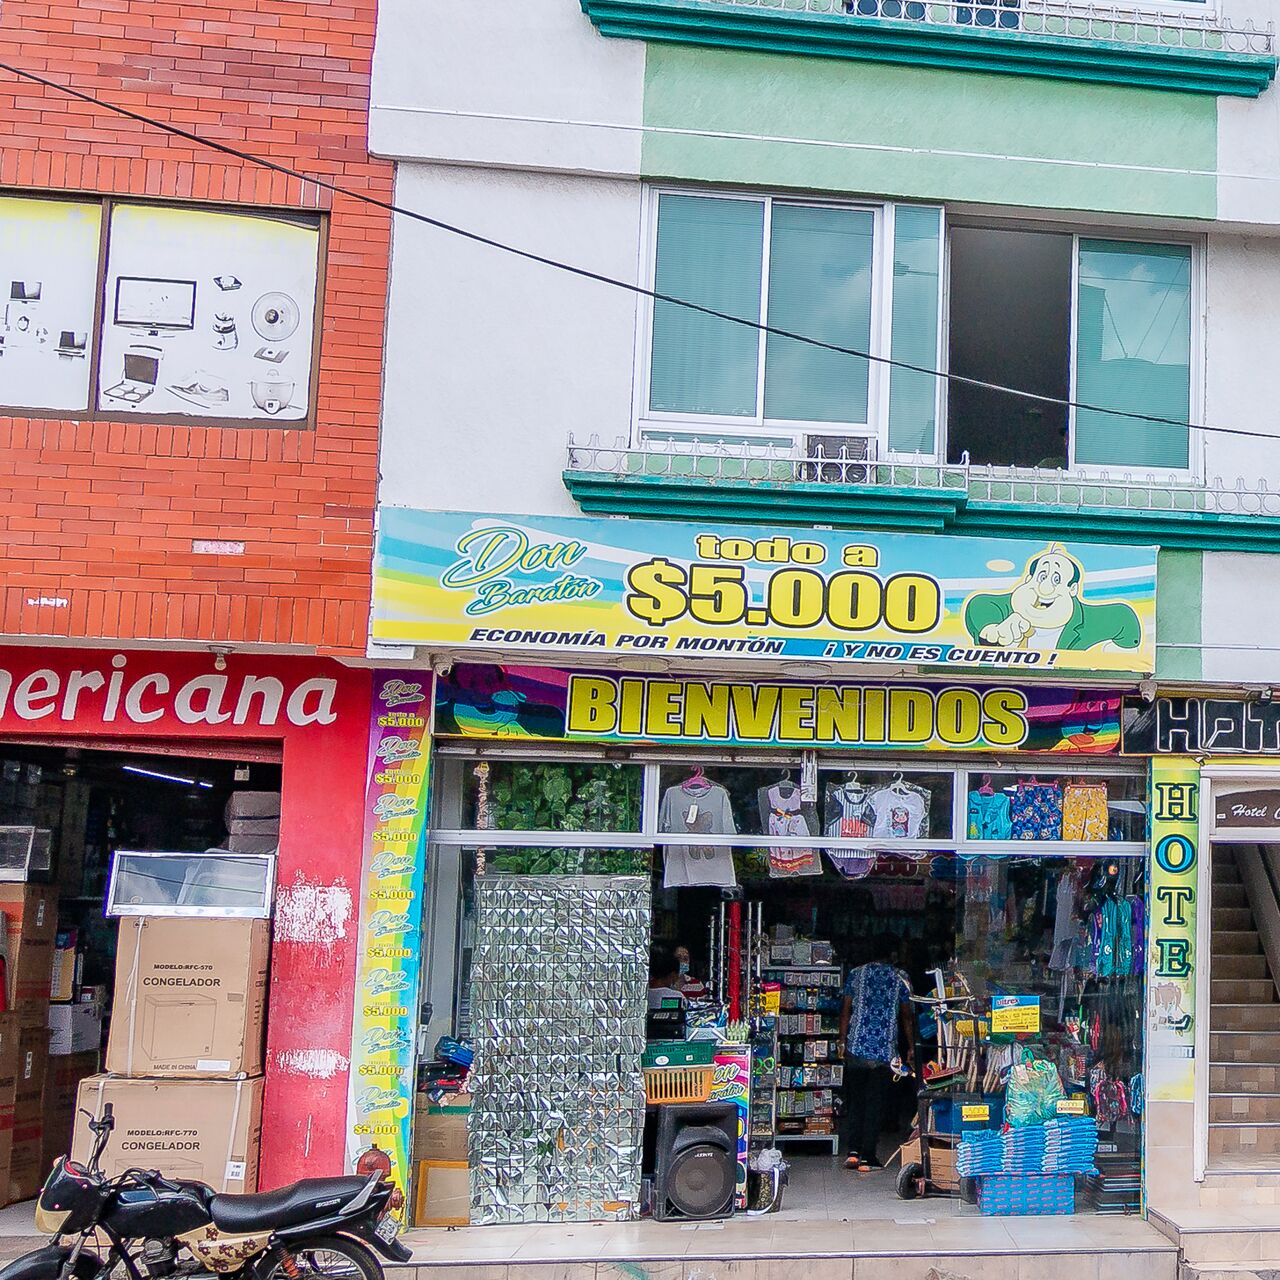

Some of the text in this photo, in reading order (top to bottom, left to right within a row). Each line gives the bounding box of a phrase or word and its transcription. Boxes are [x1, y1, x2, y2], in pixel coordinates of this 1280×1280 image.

[443, 527, 588, 588] Don
[697, 535, 880, 568] todo a
[464, 574, 602, 617] Baratón
[626, 557, 940, 634] $5.000
[469, 627, 607, 648] ECONOMÍA
[615, 633, 668, 650] POR
[674, 635, 784, 655] MONTÓN
[866, 645, 900, 659] NO
[908, 647, 941, 661] ES
[946, 649, 1040, 665] CUENTO
[565, 672, 1028, 748] BIENVENIDOS
[1231, 804, 1268, 817] Hotel
[142, 977, 221, 987] CONGELADOR
[713, 1063, 741, 1085] on
[121, 1141, 201, 1151] CONGELADOR
